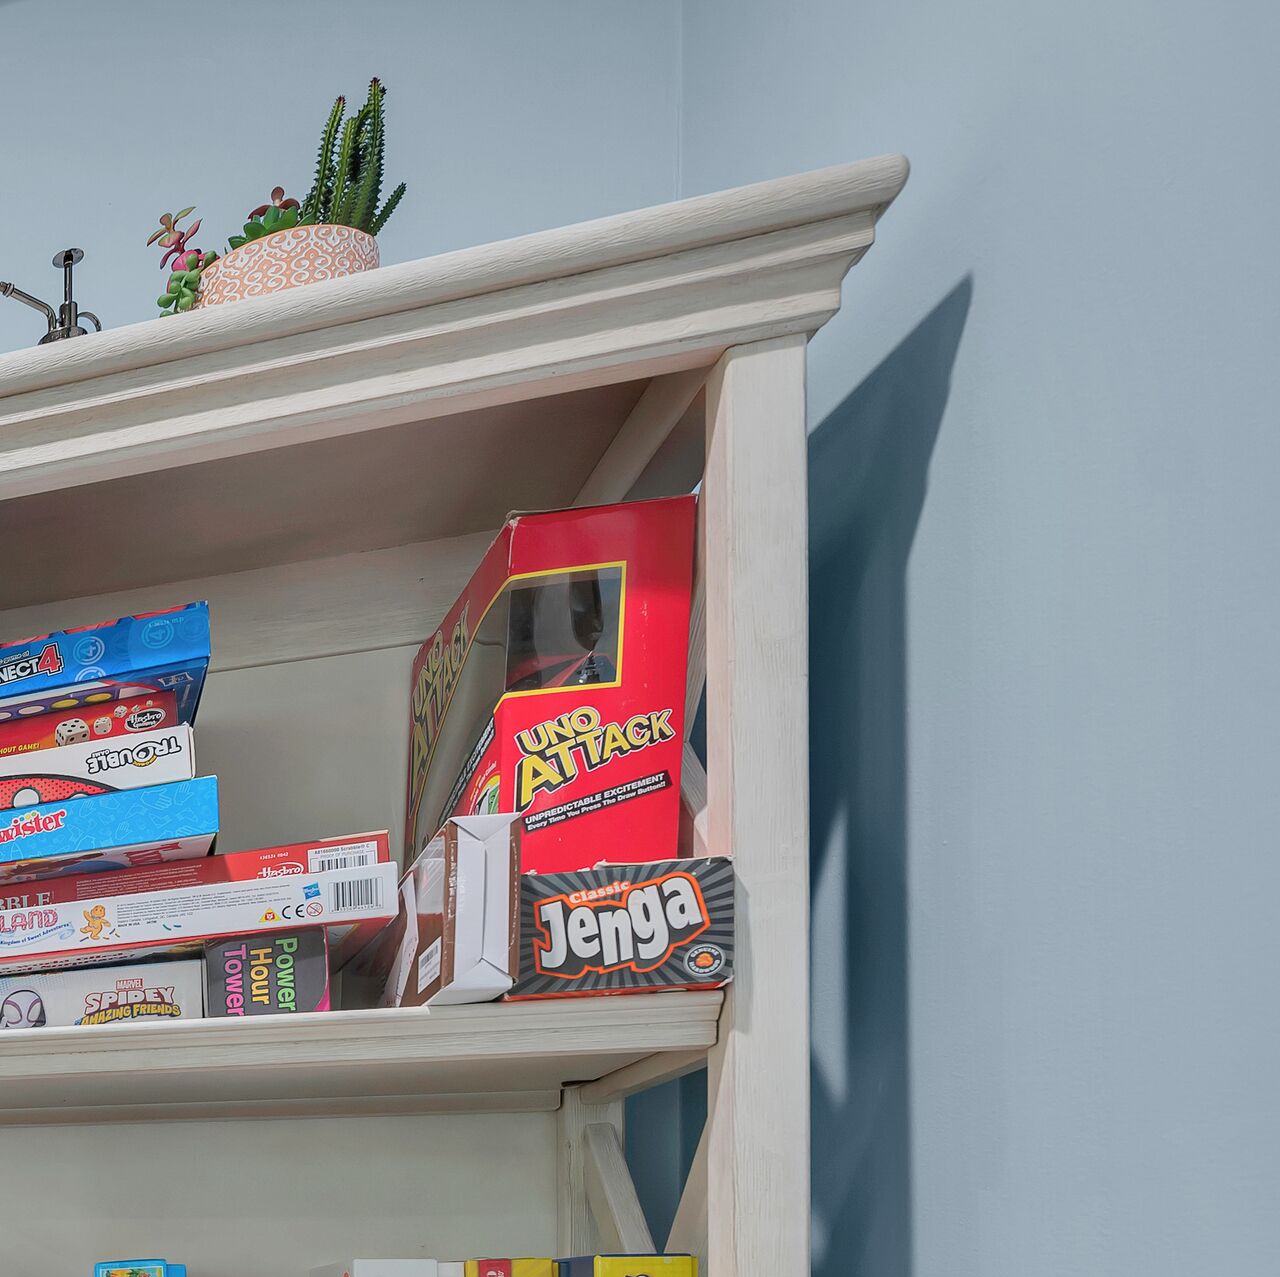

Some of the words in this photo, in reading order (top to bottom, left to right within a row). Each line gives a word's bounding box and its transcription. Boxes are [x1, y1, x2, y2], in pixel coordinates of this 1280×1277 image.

[38, 645, 60, 673] 4
[517, 707, 600, 754] UNO
[87, 736, 182, 774] TROUBLE
[517, 710, 675, 807] ATTACK
[525, 793, 602, 824] UNPREDICTABLE
[604, 772, 665, 798] EXCITEMENT
[527, 821, 547, 831] Every
[548, 814, 566, 824] Time
[567, 809, 580, 819] You
[581, 803, 602, 814] Press
[602, 798, 616, 806] The
[617, 792, 637, 802] Draw
[569, 879, 630, 904] Classic
[0, 909, 58, 934] LAND
[27, 933, 41, 941] Sweet
[540, 876, 704, 969] Jenga
[117, 979, 143, 990] MARVEL
[224, 944, 246, 1016] Tower
[250, 948, 269, 1005] Hour
[275, 936, 298, 1012] Power
[81, 1004, 131, 1025] AMAZING
[133, 1003, 181, 1018] FRIENDS
[85, 987, 175, 1015] SPIDEY
